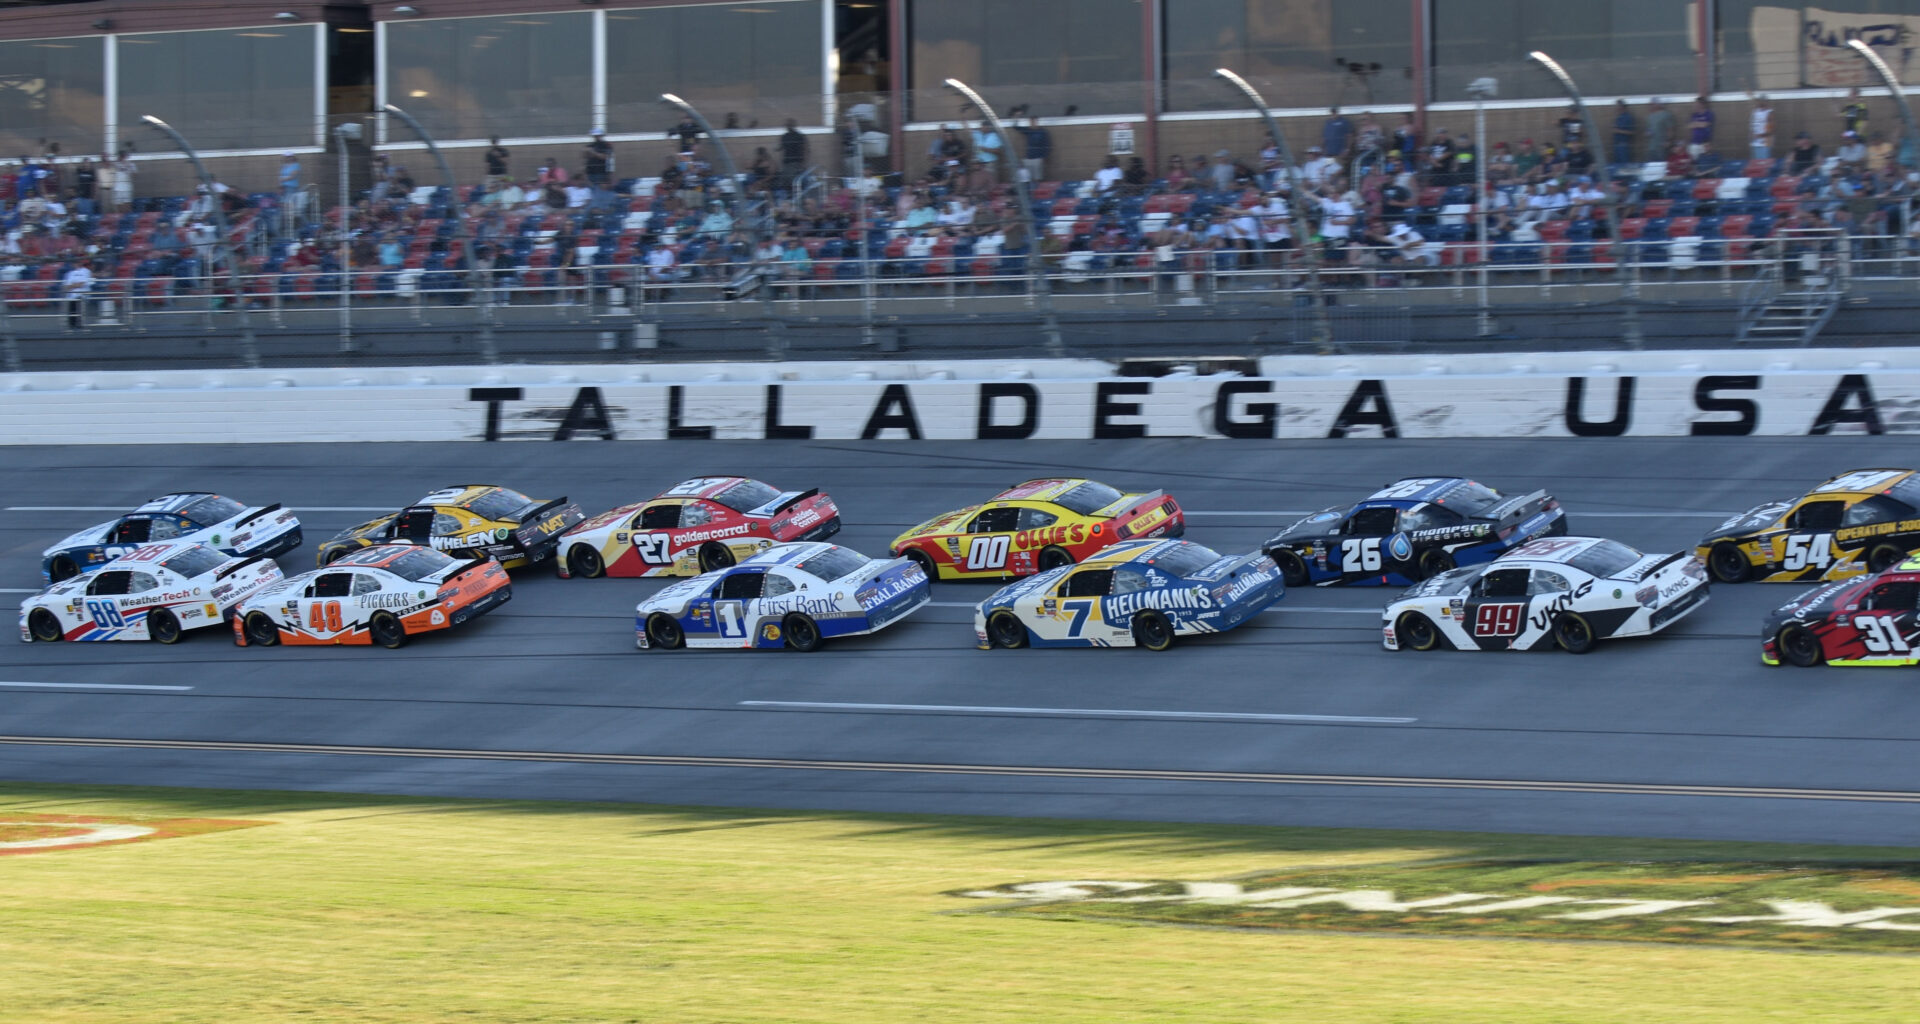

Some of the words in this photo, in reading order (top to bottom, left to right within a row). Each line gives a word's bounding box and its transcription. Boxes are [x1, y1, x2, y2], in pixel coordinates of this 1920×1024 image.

[467, 375, 1399, 442] TALLADEGA
[1565, 373, 1885, 437] USA
[429, 529, 496, 550] WHELEN
[537, 514, 565, 535] WAT
[673, 530, 711, 547] golden
[710, 523, 750, 538] corral
[1015, 523, 1085, 550] OLLIE'S
[1411, 529, 1490, 542] PIPEGROP
[1836, 521, 1897, 541] OPERATION
[117, 544, 172, 562] 88
[633, 532, 673, 565] 27
[967, 535, 1011, 570] 00
[1341, 537, 1382, 573] 26
[1783, 533, 1832, 571] 54
[120, 589, 190, 607] WeatherTech
[219, 573, 277, 603] WeatherTech
[360, 592, 409, 609] PICKERS
[1227, 570, 1273, 602] HELLMANN'S
[86, 599, 126, 629] 88
[309, 601, 343, 633] 48
[397, 604, 427, 617] VODKA
[758, 596, 790, 616] First
[796, 593, 842, 615] Bank
[1106, 584, 1212, 620] HELLMANN'S
[719, 603, 742, 636] 1
[1062, 600, 1093, 638] 7
[1475, 604, 1522, 635] 99
[1854, 615, 1910, 652] 31
